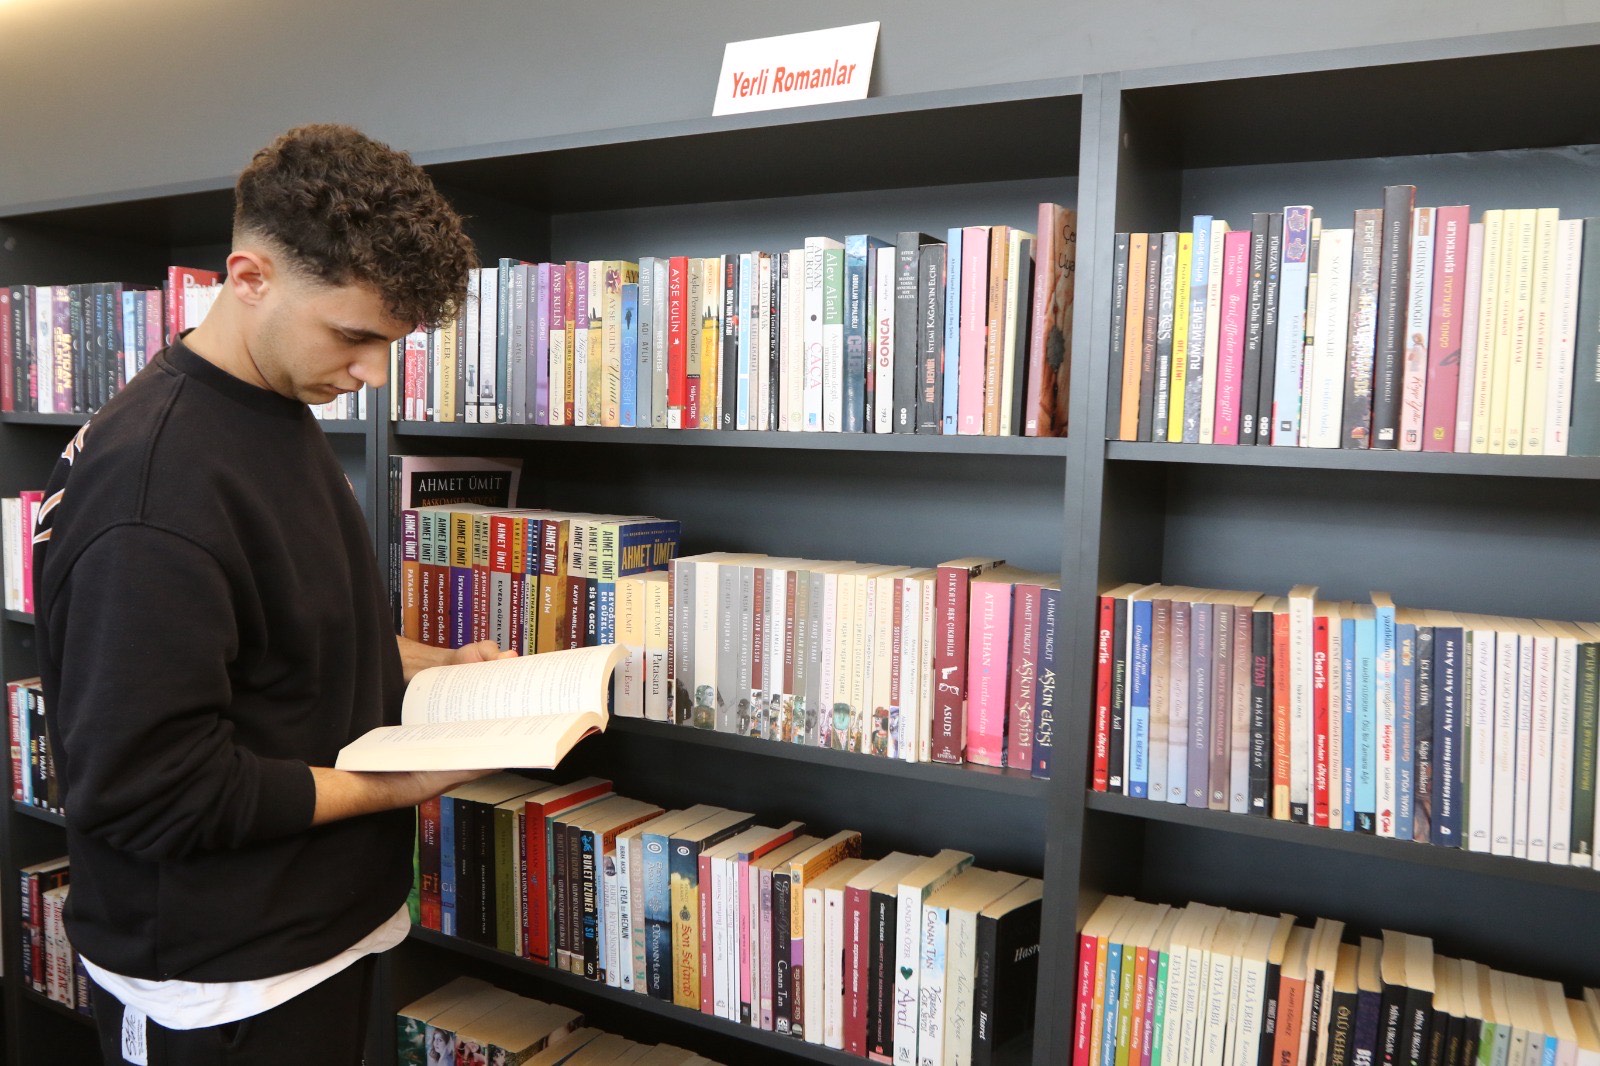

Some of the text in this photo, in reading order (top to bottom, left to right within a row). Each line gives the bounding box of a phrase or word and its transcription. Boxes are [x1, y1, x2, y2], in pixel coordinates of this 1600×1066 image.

[732, 59, 856, 98] Yerli Romanlar
[805, 243, 814, 291] TURGUT
[813, 245, 822, 288] ADNAN
[1253, 233, 1264, 271] FÜRUZAN
[552, 271, 563, 326] AYŞE KULİN
[577, 268, 587, 325] AYŞE KULİN
[641, 267, 651, 306] AYŞE KULİN
[671, 268, 681, 332] AYŞE KULİN
[825, 252, 838, 320] Alev Alatlı
[1412, 240, 1428, 328] GÜLİSTAN SİNANOĞLU
[1439, 220, 1457, 348] GÖNÜL ÇATALCALI EŞİKTEKİLER
[1249, 280, 1262, 350] Sevda Dolu Bir Yaz
[880, 317, 890, 368] GONCA
[623, 336, 635, 405] Gece Sesleri
[419, 476, 503, 492] AHMET ÜMİT
[404, 514, 415, 538] AHMET
[422, 516, 431, 542] AHMET
[437, 517, 447, 542] AHMET
[456, 519, 466, 544] AHMET
[496, 522, 506, 548] AHMET
[573, 526, 583, 551] AHMET
[405, 541, 418, 559] ÜMİT
[422, 543, 434, 562] ÜMİT
[437, 544, 449, 564] ÜMİT
[456, 546, 468, 565] ÜMİT
[496, 551, 506, 570] ÜMİT
[544, 524, 557, 614] AHMET ÜMİT KAVİM
[572, 552, 584, 571] ÜMİT
[601, 530, 615, 580] AHMET ÜMİT
[621, 537, 677, 570] AHMET ÜMİT
[421, 571, 429, 611] KIRLANGIÇ
[457, 575, 465, 611] İSTANBUL
[571, 584, 579, 605] KAYIP
[588, 526, 598, 635] AHMET ÜMİT SİS VE GECE
[624, 583, 632, 612] AHMET
[437, 615, 445, 644] ÇIĞLIĞI
[496, 608, 504, 632] GÜZEL
[600, 591, 608, 629] EN GÜZEL
[945, 573, 957, 657] DİKKAT! AŞK ÇIKABİLİR
[1022, 592, 1033, 656] AHMET TURGUT
[1044, 597, 1056, 662] AHMET TURGUT
[652, 585, 663, 695] AHMET ÜMİT Patasana
[624, 675, 633, 696] Esrar
[978, 592, 995, 737] ATTİLÂ İLHAN kurtlar sofrası
[1096, 629, 1111, 758] Charlie Handan GÖKÇEK
[1254, 655, 1268, 769] ZİYAN HAKAN GÜNDAY
[942, 704, 953, 737] ASUDE
[1314, 651, 1327, 791] Charlie Handan GÖKÇEK
[38, 735, 46, 753] KAN
[1134, 718, 1145, 771] HALİL BEZMEN
[1275, 705, 1289, 780] ve sonra yol bitti
[21, 877, 30, 918] TED BELL
[522, 902, 530, 928] GÜNCESİ
[583, 854, 594, 938] BUKET UZUNER SU
[619, 886, 629, 940] LEYLA MECNUN
[680, 923, 695, 998] Son Sefarad
[925, 910, 938, 970] CANAN TAN
[777, 959, 788, 1007] Canan Tan
[896, 897, 916, 1034] CANDAN ÖZER Araf
[1108, 969, 1118, 1005] Latife Tekin
[1385, 1004, 1399, 1055] MİNA URGAN
